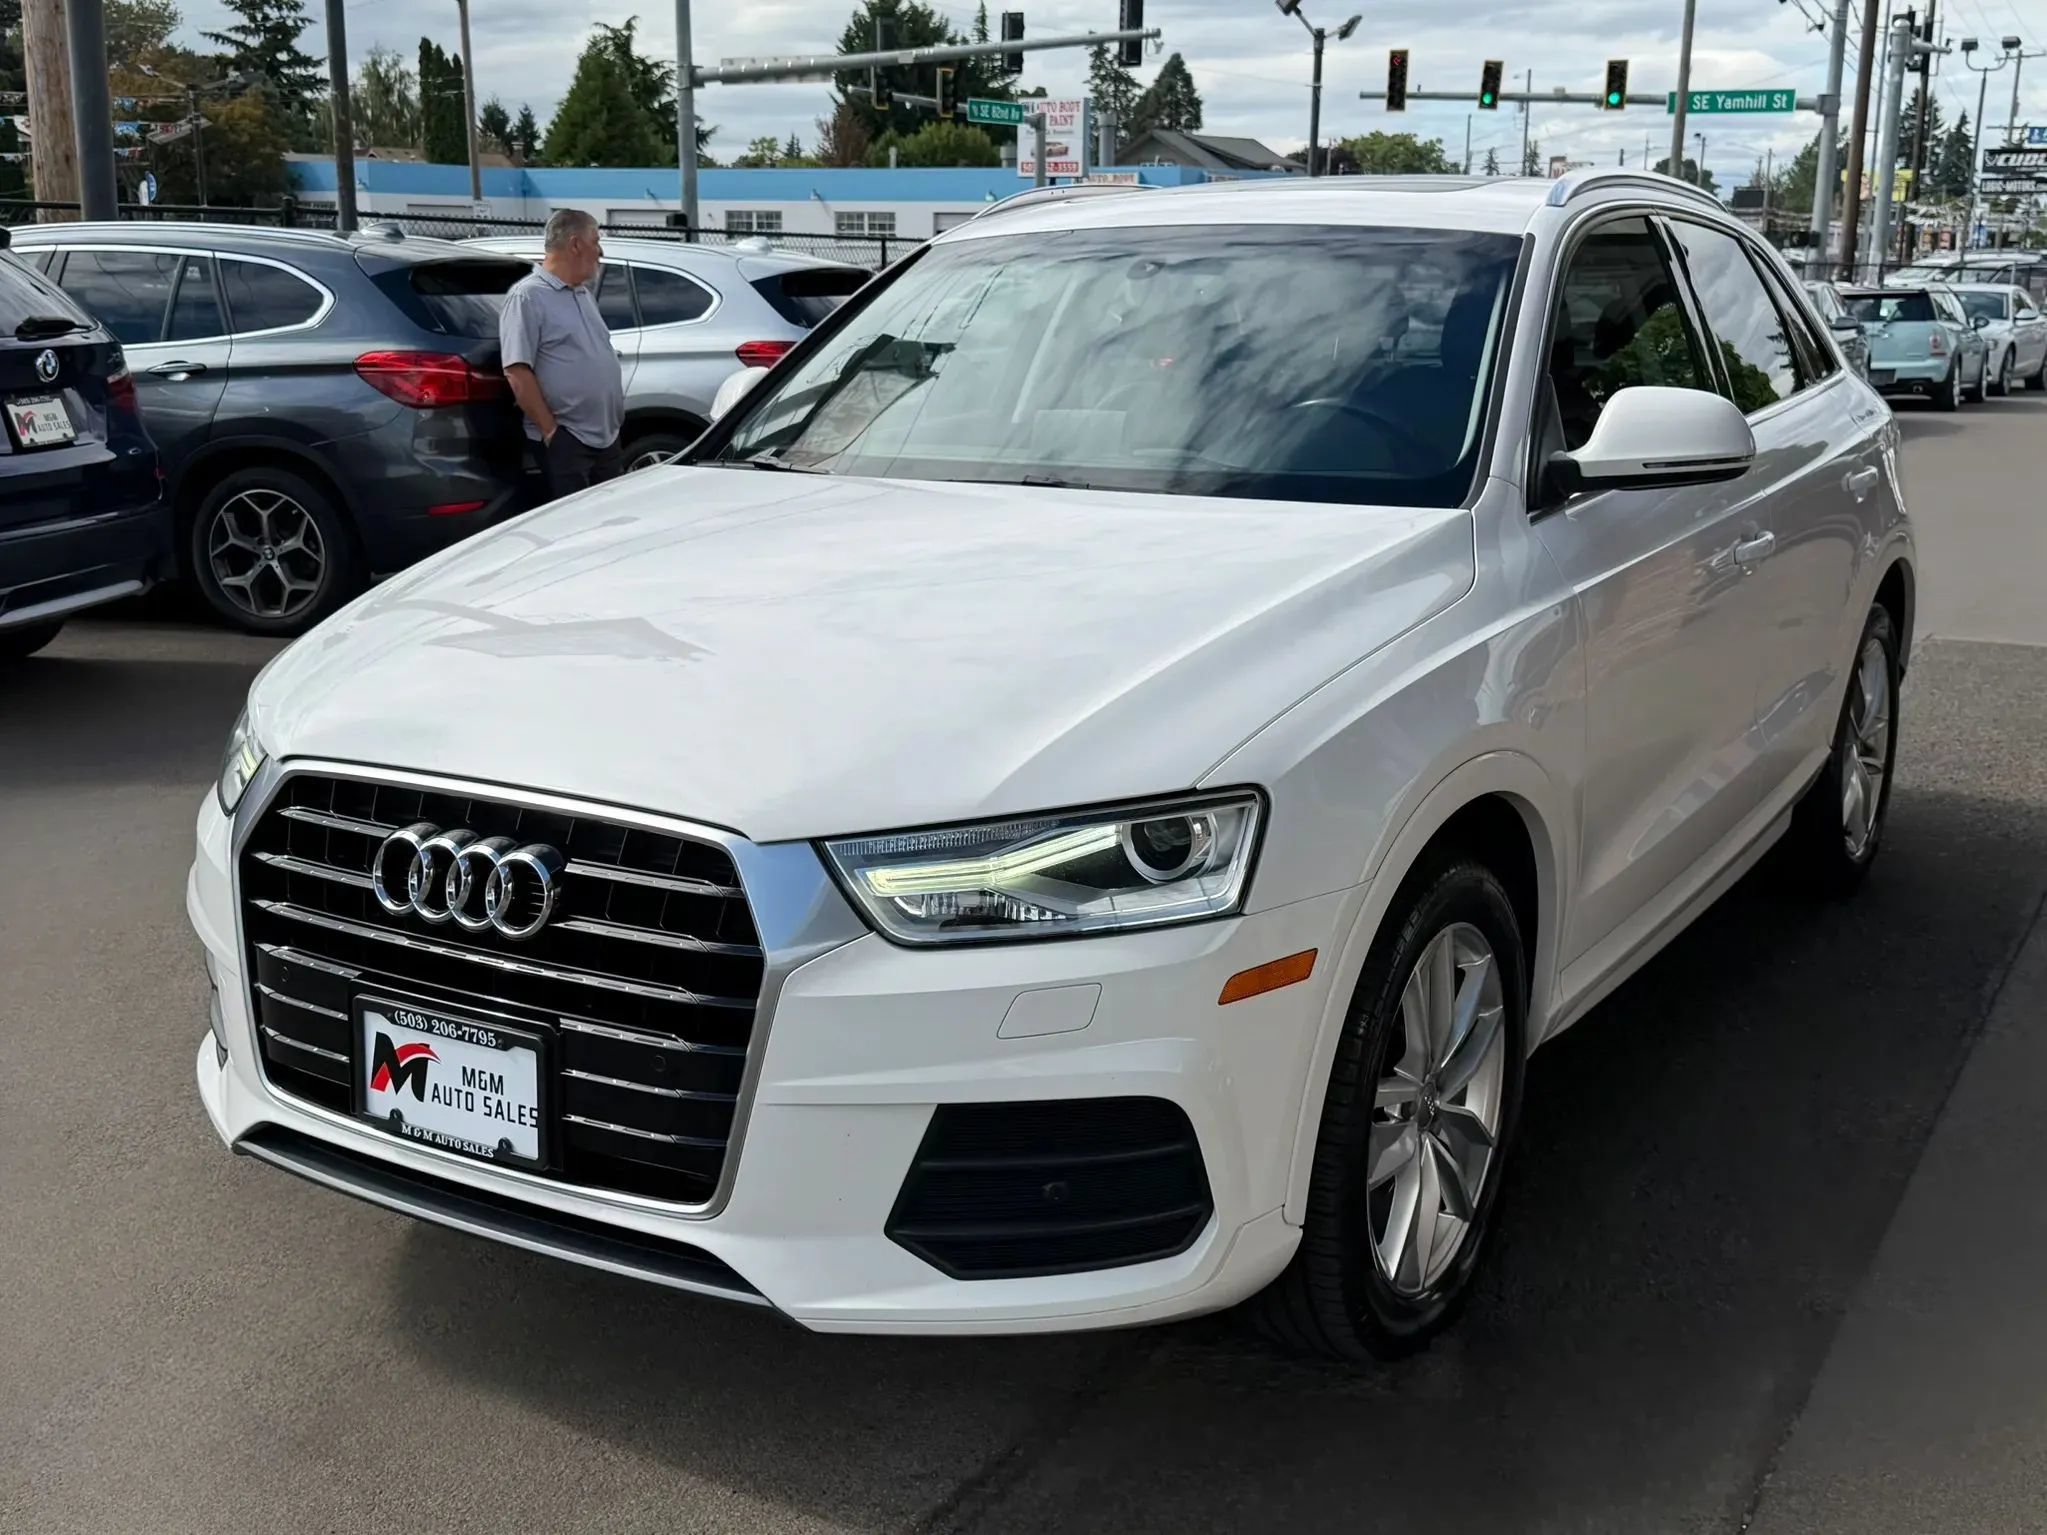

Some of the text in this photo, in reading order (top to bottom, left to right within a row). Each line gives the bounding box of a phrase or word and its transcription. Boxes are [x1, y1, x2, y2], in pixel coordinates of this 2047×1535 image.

[979, 104, 990, 118] SE
[991, 105, 1009, 120] 82nd
[1010, 107, 1020, 120] Av
[1692, 93, 1788, 110] SE Yamhill St
[37, 420, 72, 432] AUTO SALES
[393, 1009, 497, 1048] (503) 206-7795
[462, 1065, 504, 1096] M&M
[431, 1082, 539, 1128] AUTO SALES
[401, 1123, 495, 1159] M & M AUTO SALES
